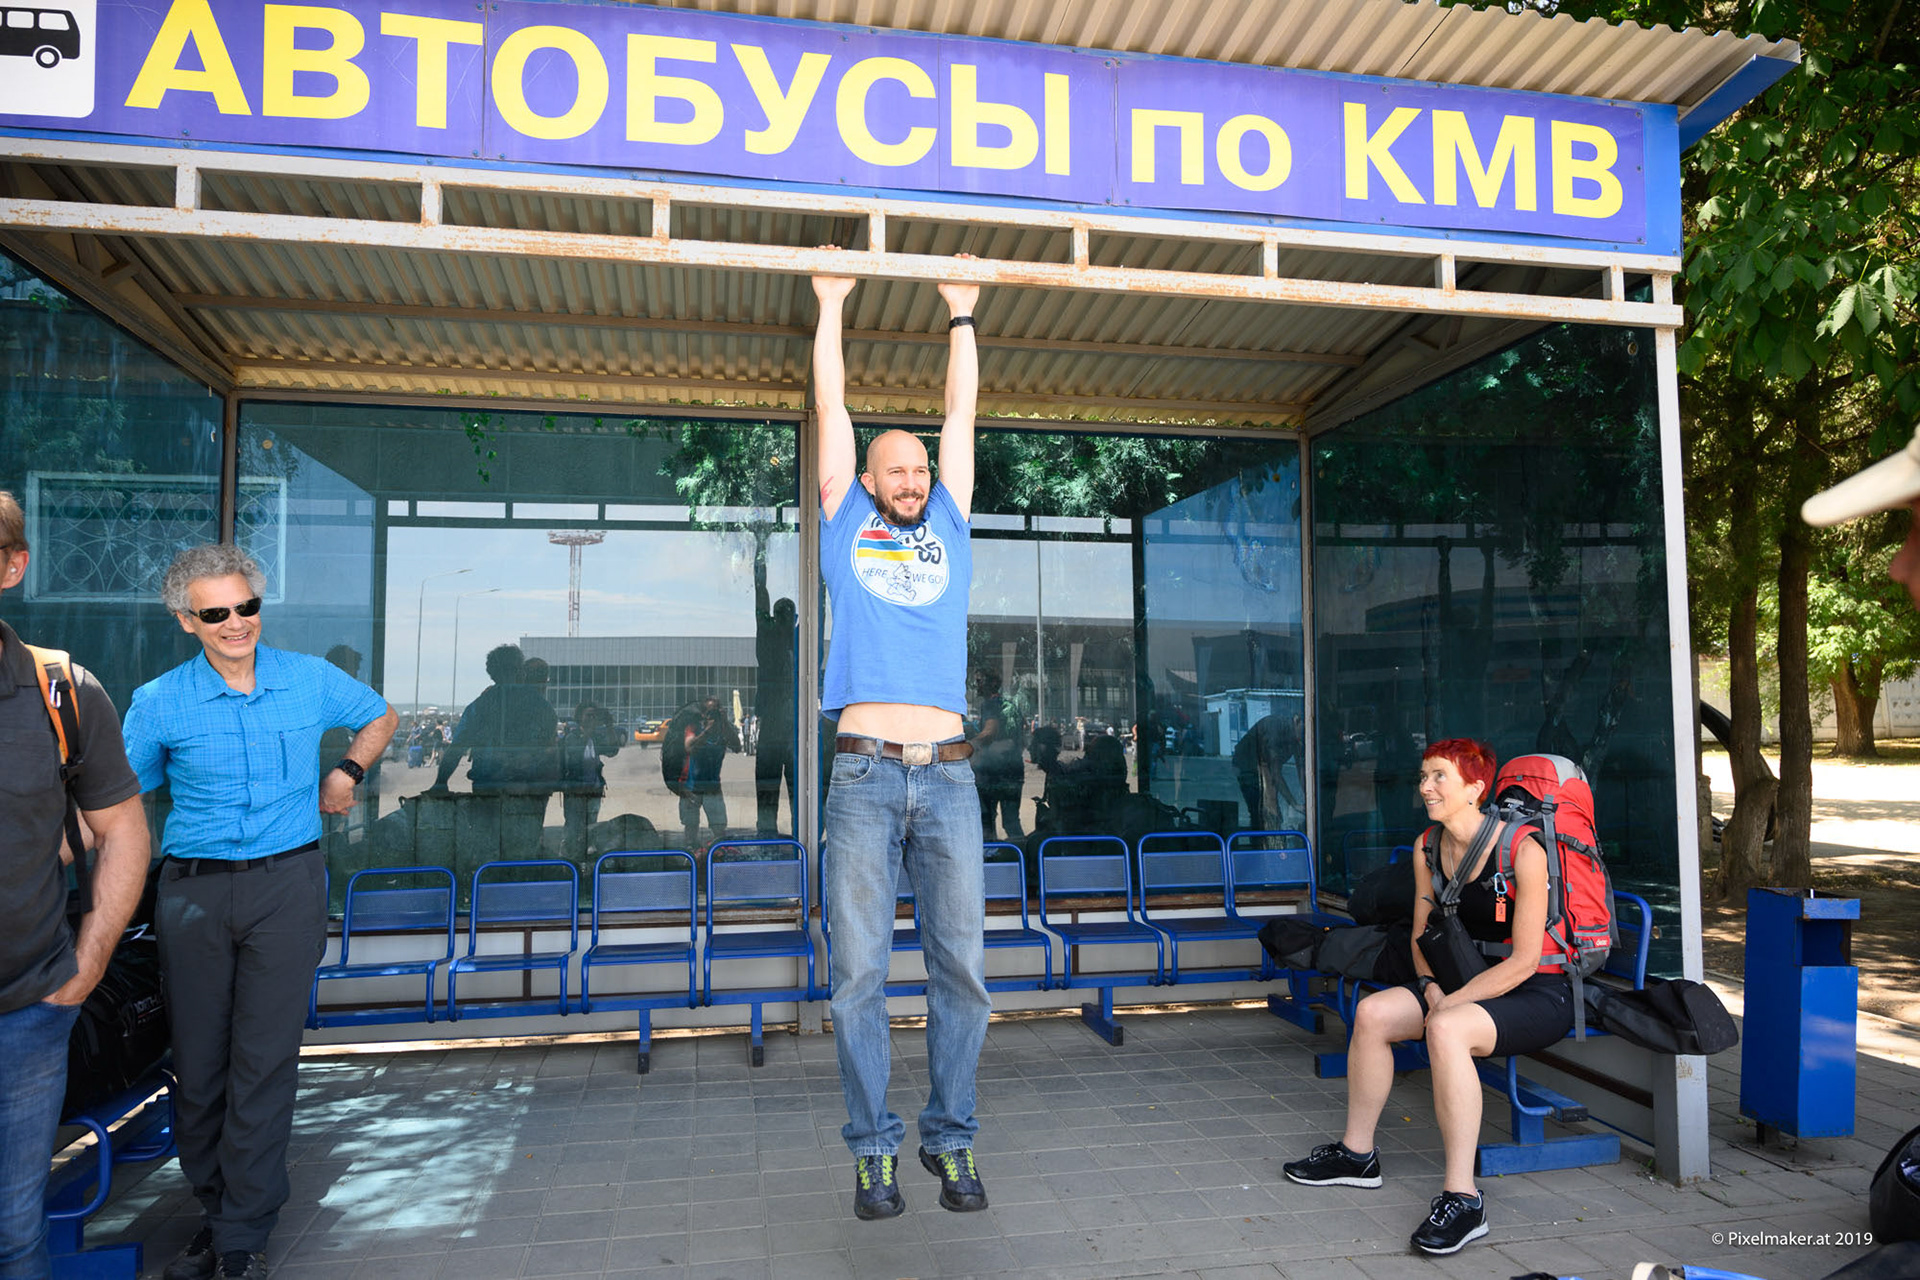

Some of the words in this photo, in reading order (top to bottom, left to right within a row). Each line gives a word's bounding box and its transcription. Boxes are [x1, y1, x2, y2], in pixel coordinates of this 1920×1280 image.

[125, 0, 1070, 174] АВТОБУСЫ
[1132, 109, 1292, 191] по
[1344, 102, 1622, 219] КМВ
[862, 568, 888, 577] HERE
[912, 573, 927, 582] WE
[928, 574, 943, 584] GO!
